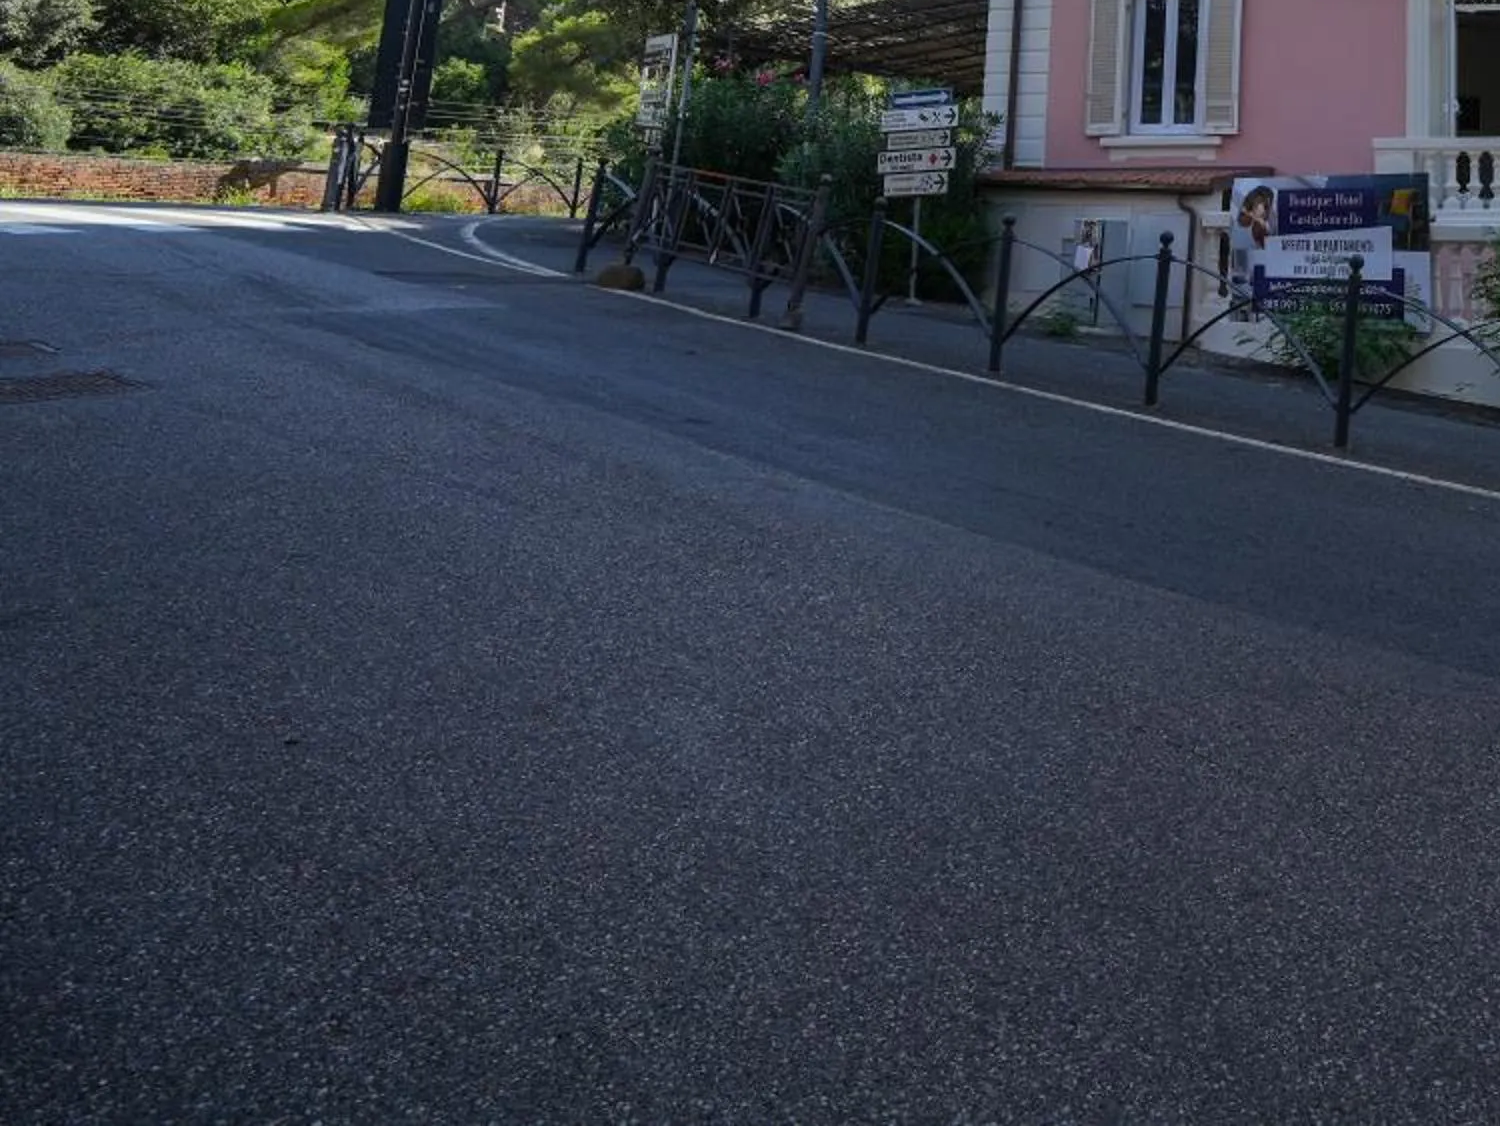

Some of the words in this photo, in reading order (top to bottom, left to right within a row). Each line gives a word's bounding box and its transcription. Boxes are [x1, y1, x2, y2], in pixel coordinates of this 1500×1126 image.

[880, 153, 923, 165] Dentista
[1288, 192, 1333, 210] Boutique
[1335, 192, 1364, 207] Hotel
[1288, 211, 1364, 227] Castiglioncello
